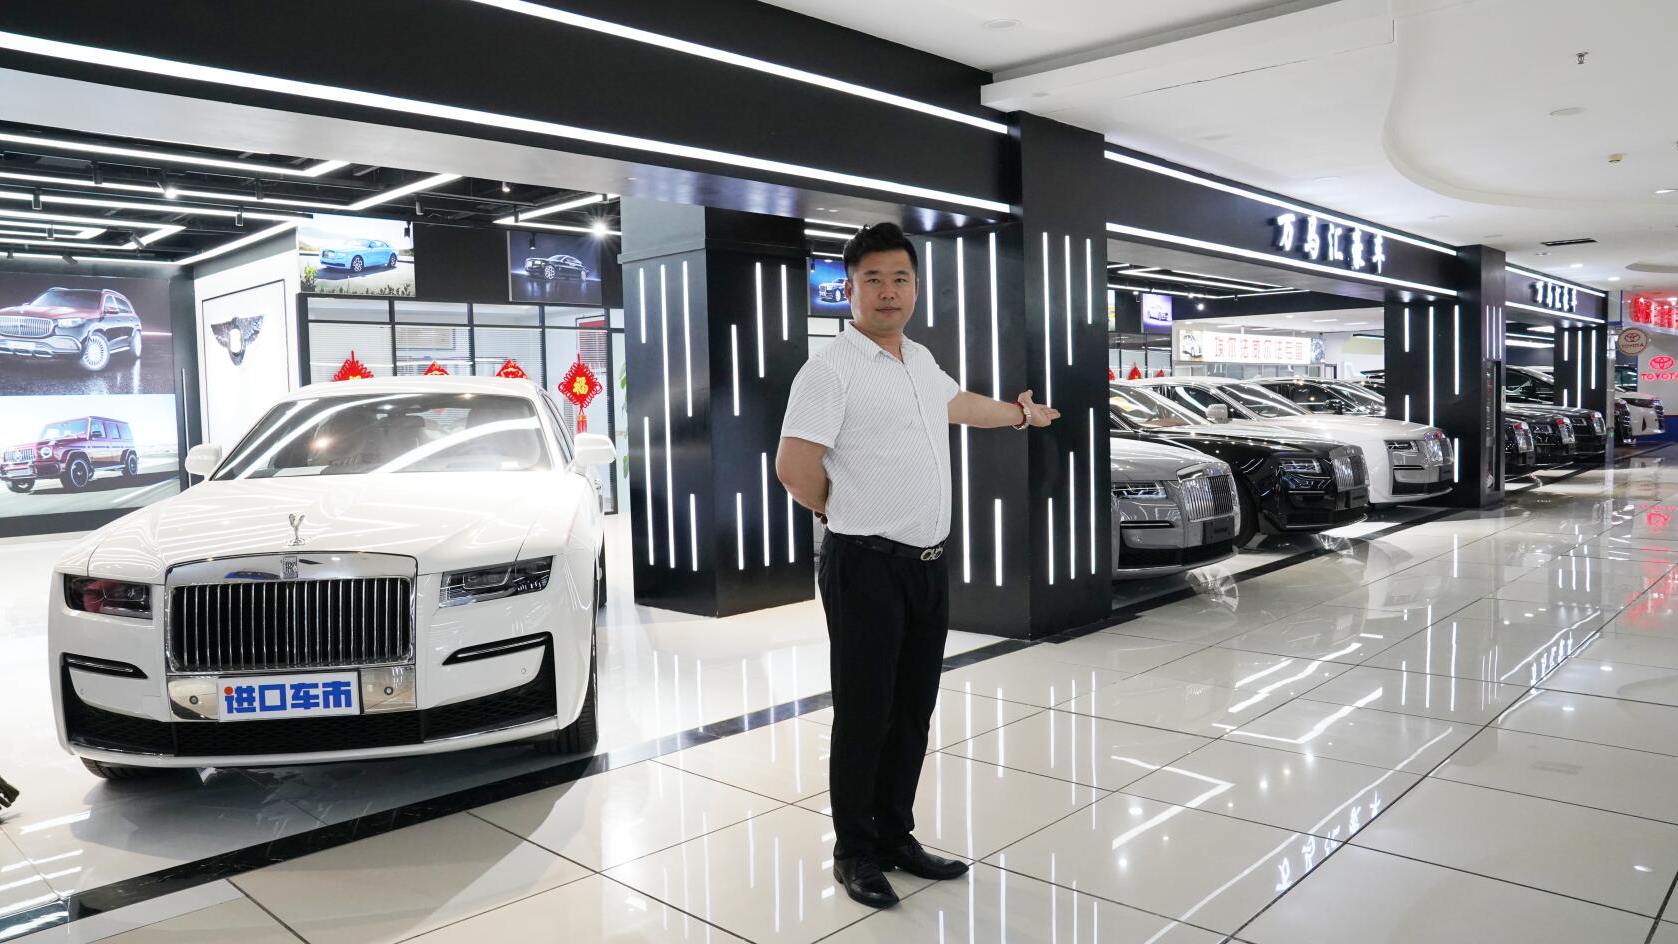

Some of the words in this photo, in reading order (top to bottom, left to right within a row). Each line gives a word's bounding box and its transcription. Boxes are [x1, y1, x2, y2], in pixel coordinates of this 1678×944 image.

[573, 376, 589, 395] 福
[224, 681, 352, 714] 进口车市
